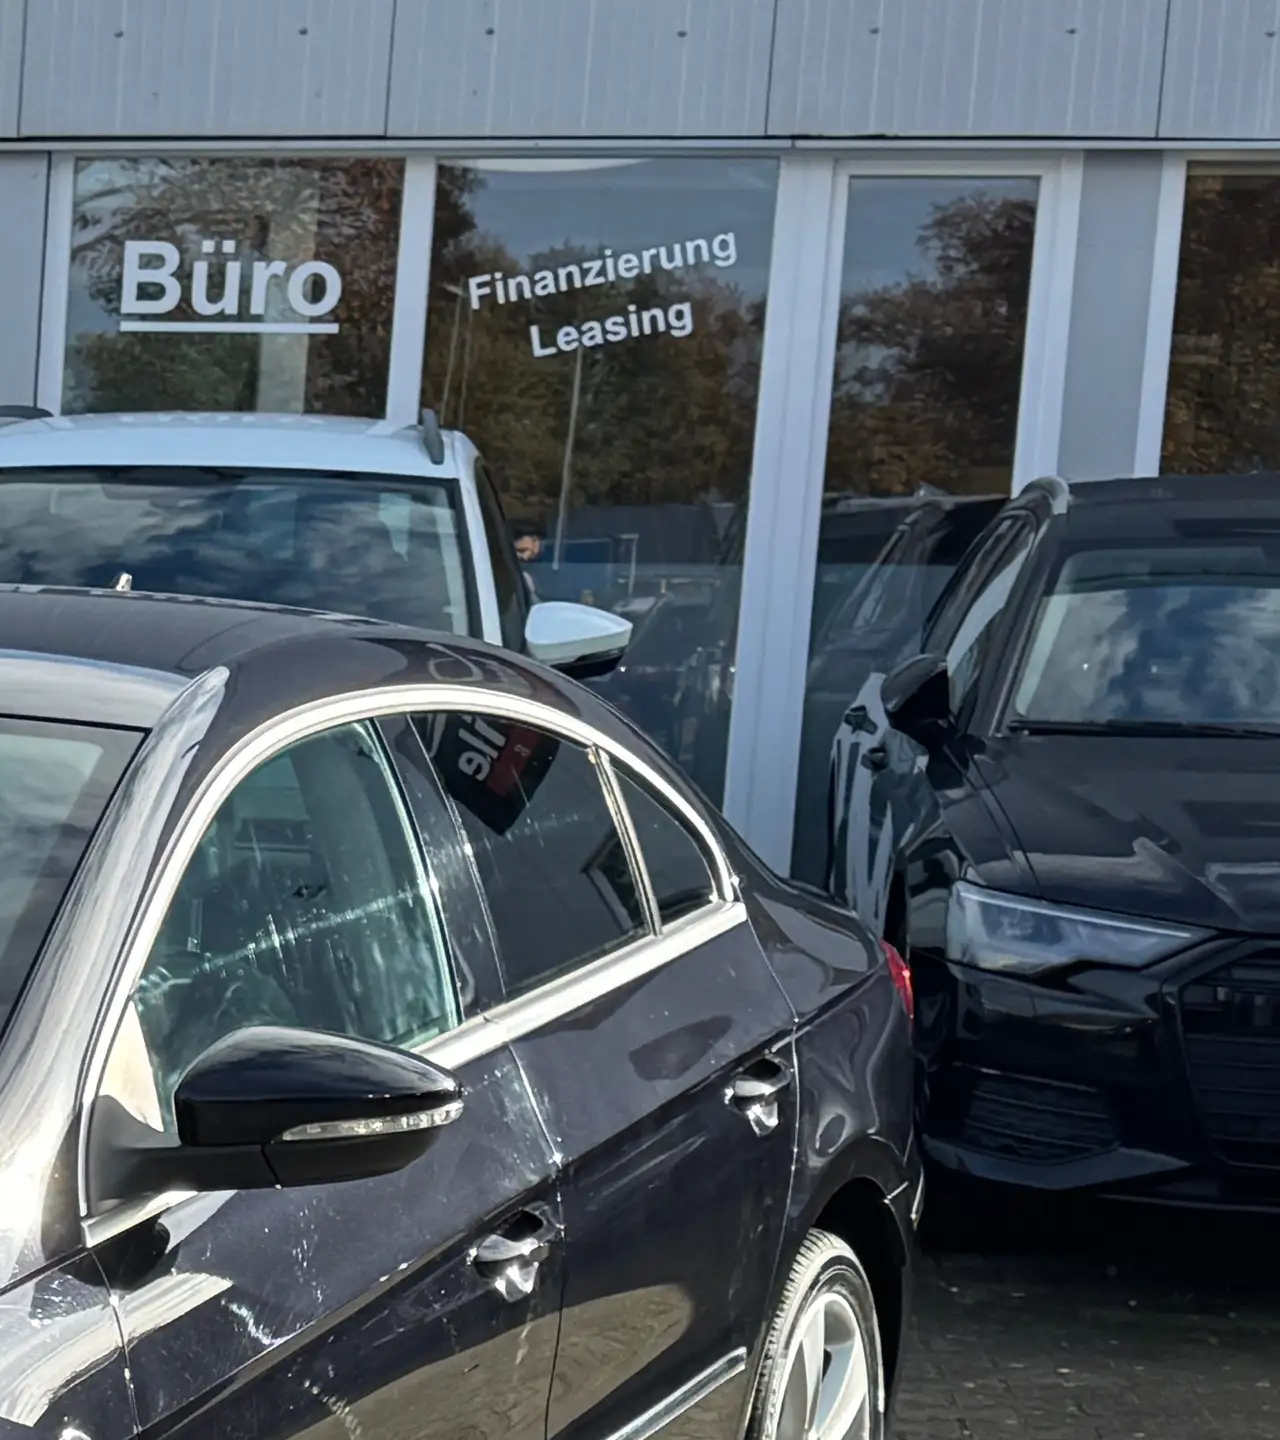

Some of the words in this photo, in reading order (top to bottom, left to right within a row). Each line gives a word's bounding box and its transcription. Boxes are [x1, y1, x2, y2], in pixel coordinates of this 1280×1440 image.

[119, 239, 343, 318] Büro
[467, 231, 739, 311] Finanzierung
[528, 300, 694, 358] Leasing
